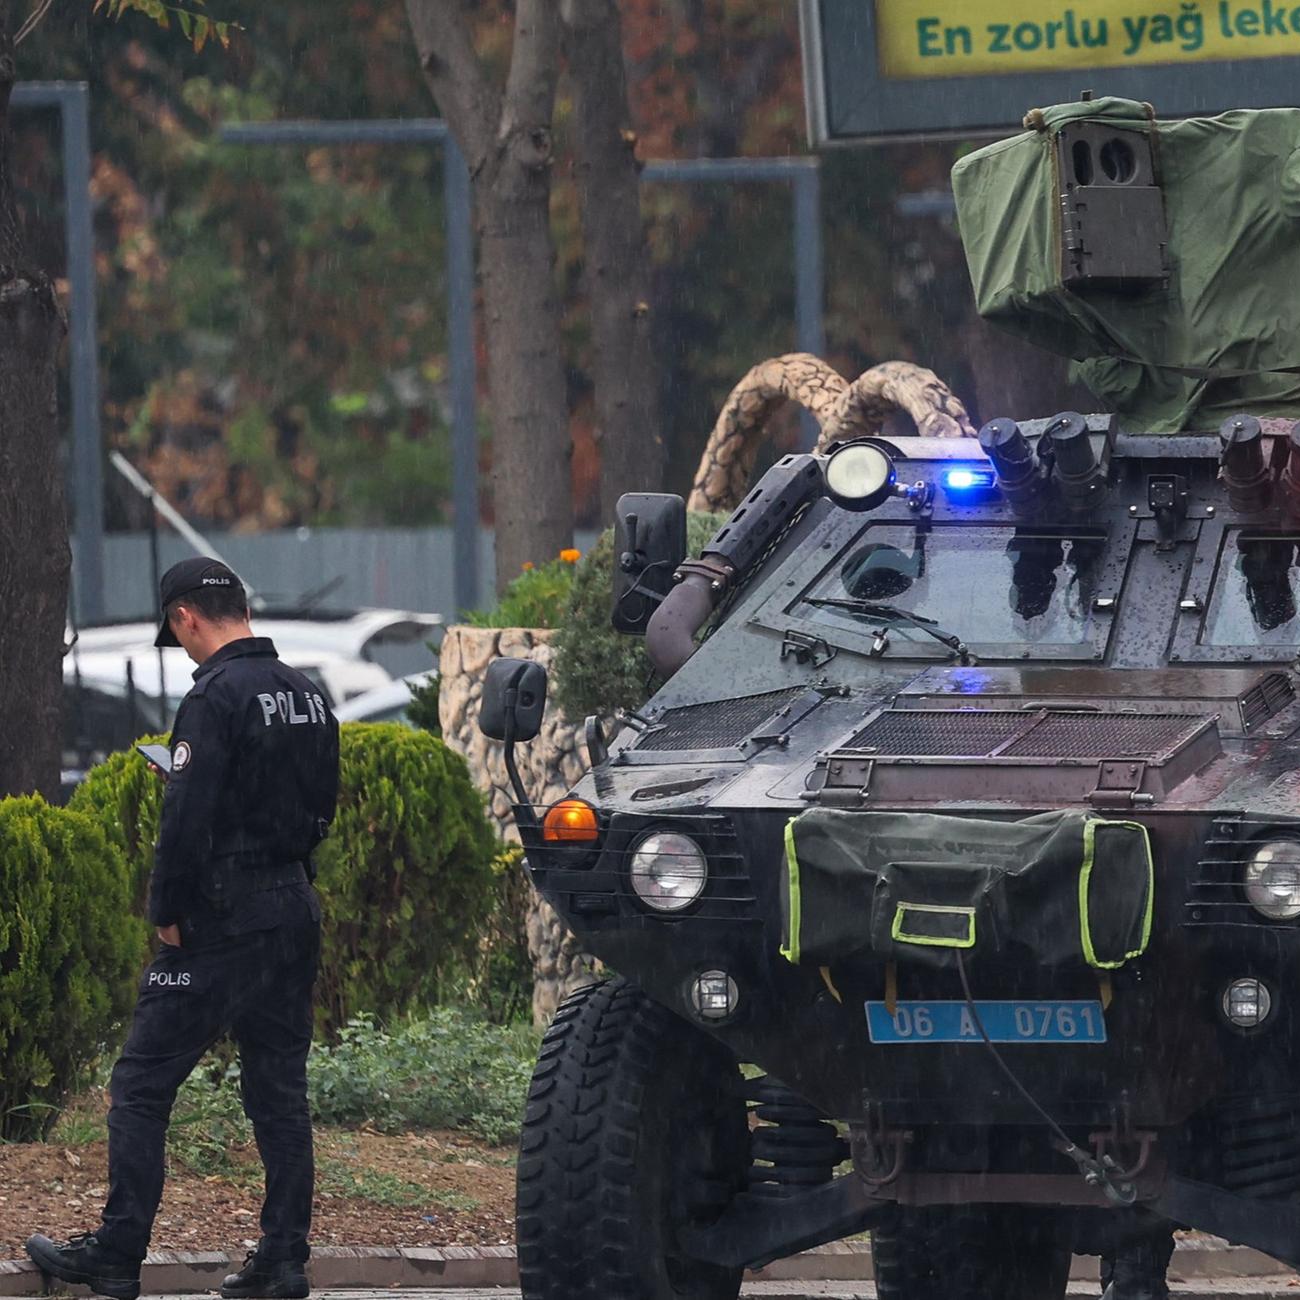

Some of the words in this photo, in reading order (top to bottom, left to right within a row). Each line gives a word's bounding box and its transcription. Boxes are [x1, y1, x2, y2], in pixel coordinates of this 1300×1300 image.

[917, 17, 971, 57] En
[987, 10, 1107, 53] zorlu
[1123, 3, 1204, 56] yağ
[892, 1006, 934, 1037] 06
[959, 1006, 978, 1036] A
[1015, 1006, 1096, 1038] 0761
